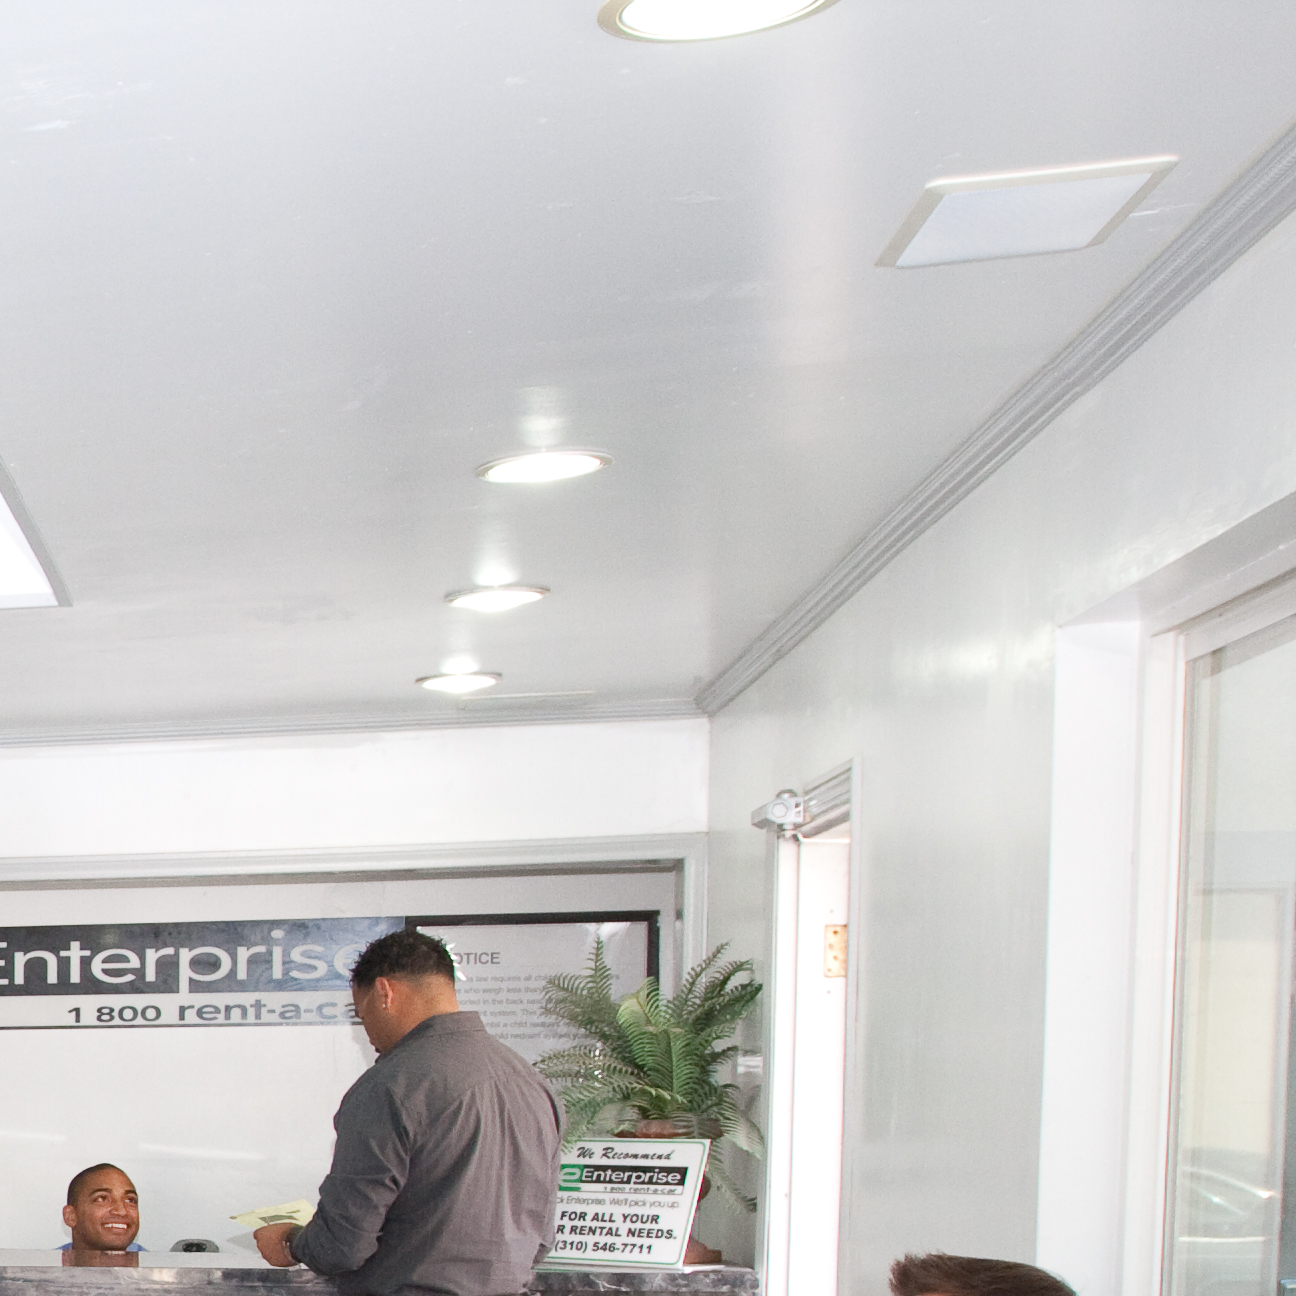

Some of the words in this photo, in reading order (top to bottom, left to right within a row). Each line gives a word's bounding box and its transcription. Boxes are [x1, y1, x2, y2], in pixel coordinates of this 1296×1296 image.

[454, 951, 501, 965] OTICE
[67, 1007, 82, 1024] 1
[95, 1005, 162, 1023] 800
[178, 1000, 356, 1022] rent-a-ca
[576, 1146, 595, 1159] We
[600, 1147, 675, 1160] Recommend
[581, 1168, 681, 1185] Enterprise
[628, 1198, 647, 1208] pick
[649, 1200, 665, 1209] you
[560, 1211, 587, 1222] FOR
[591, 1211, 616, 1223] ALL
[622, 1213, 660, 1225] YOUR
[569, 1225, 622, 1237] RENTAL
[626, 1228, 677, 1240] NEEDS.
[554, 1240, 588, 1253] (310)
[592, 1242, 653, 1254] 546-7711
